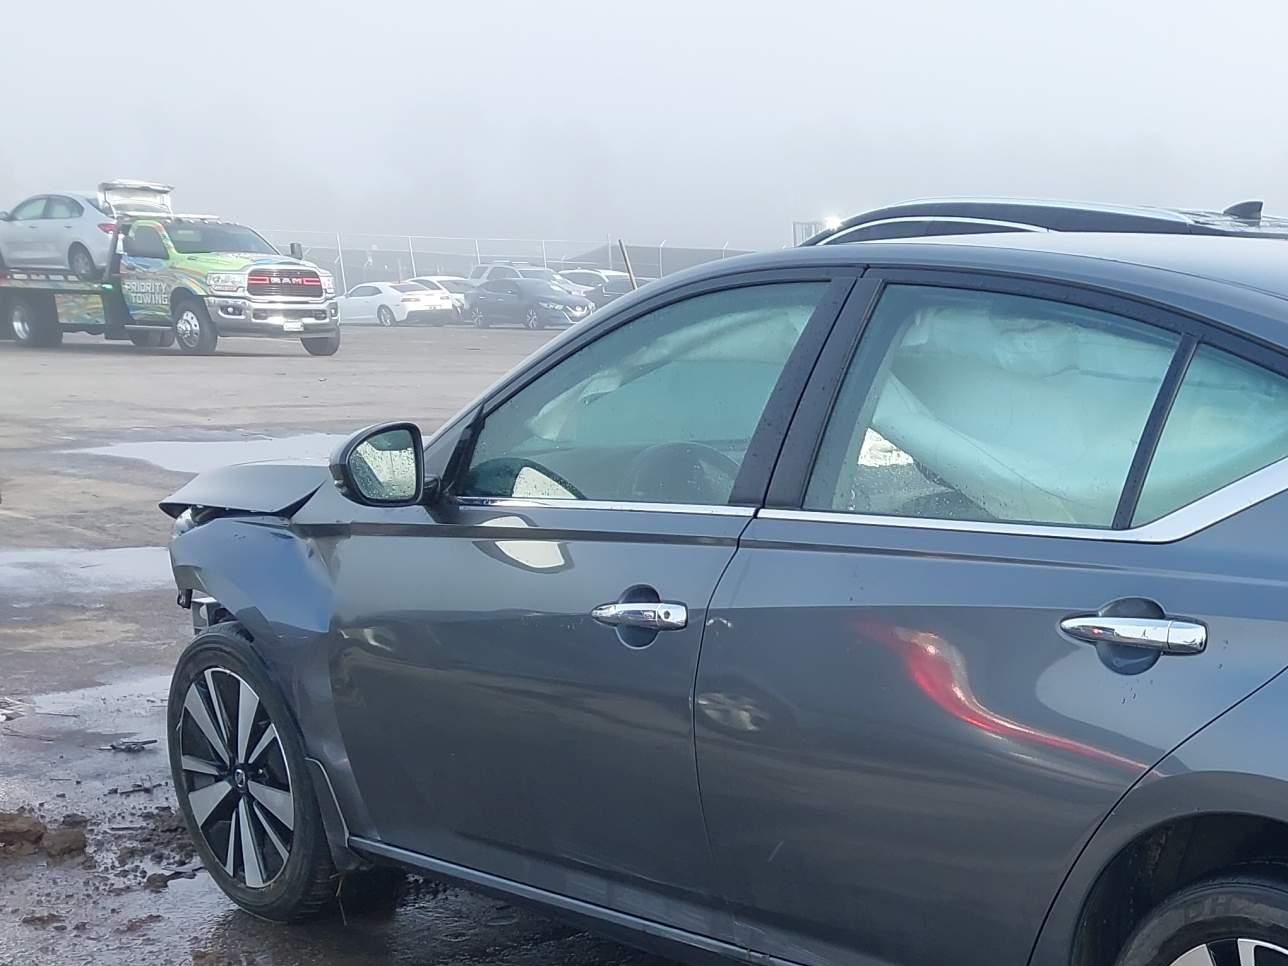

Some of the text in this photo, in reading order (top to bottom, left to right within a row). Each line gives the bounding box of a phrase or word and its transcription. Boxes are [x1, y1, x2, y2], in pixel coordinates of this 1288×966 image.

[124, 281, 168, 293] PRIORITY
[271, 277, 302, 285] RAM
[131, 293, 169, 305] TOWING
